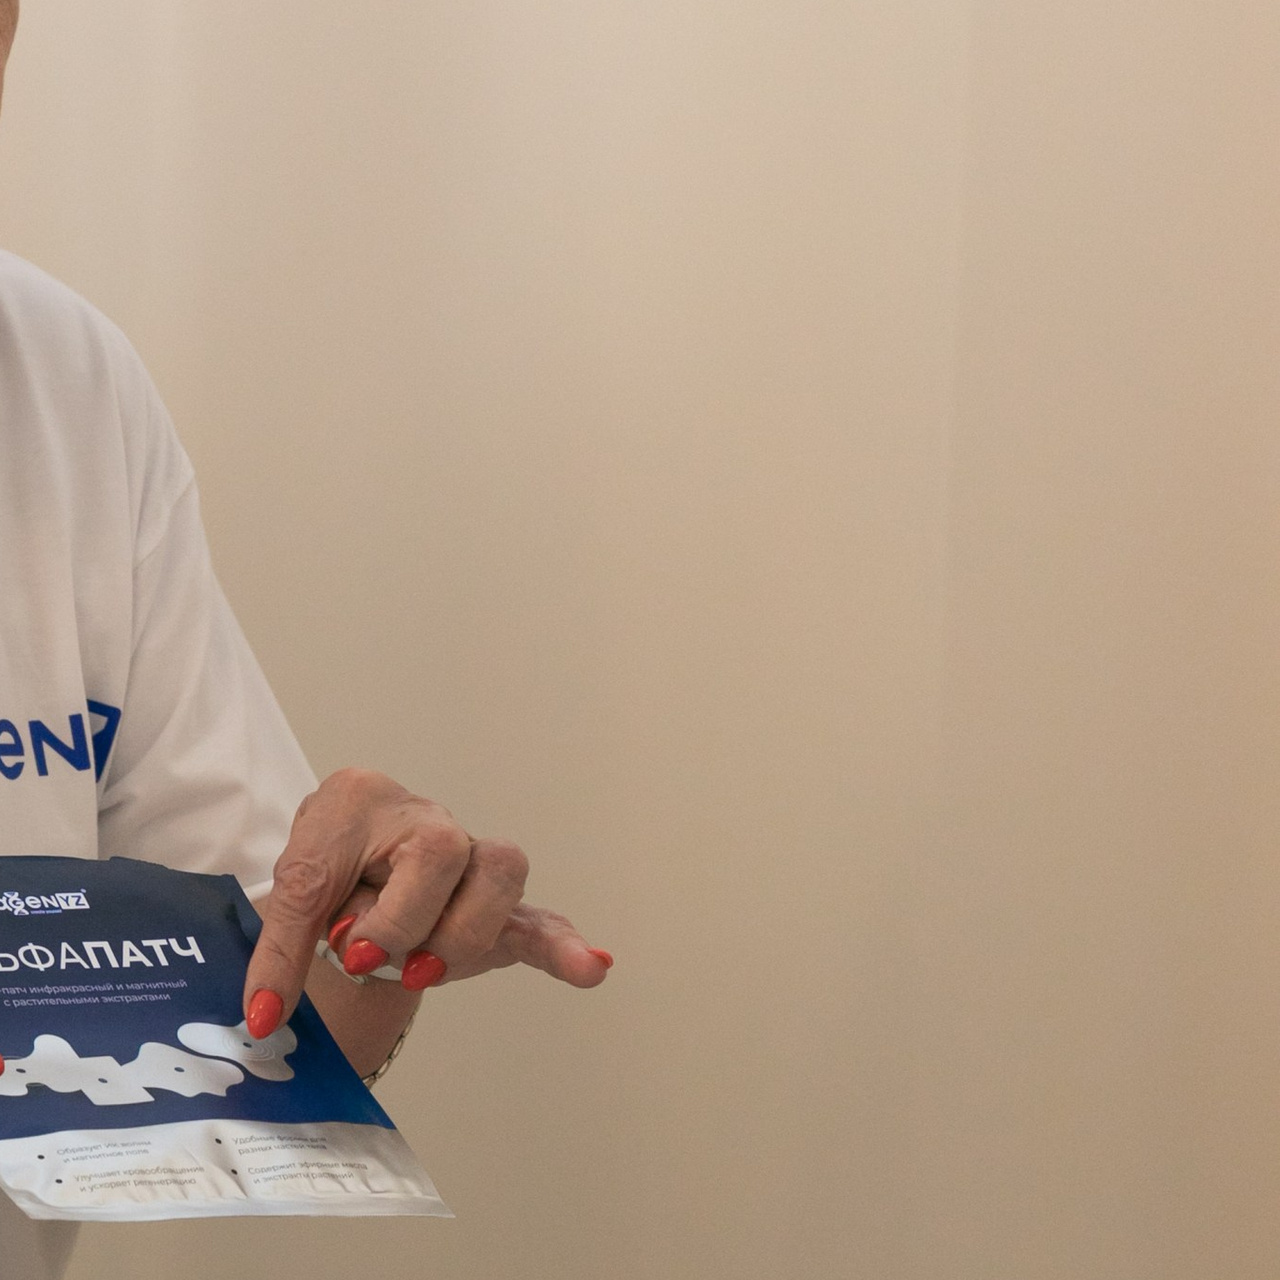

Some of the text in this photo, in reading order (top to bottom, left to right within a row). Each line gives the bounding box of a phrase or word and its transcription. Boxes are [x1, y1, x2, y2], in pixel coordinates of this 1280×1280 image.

[29, 982, 114, 997] инфракрасный
[125, 979, 188, 991] магнитный
[3, 993, 171, 1008] с растительными экстрактами
